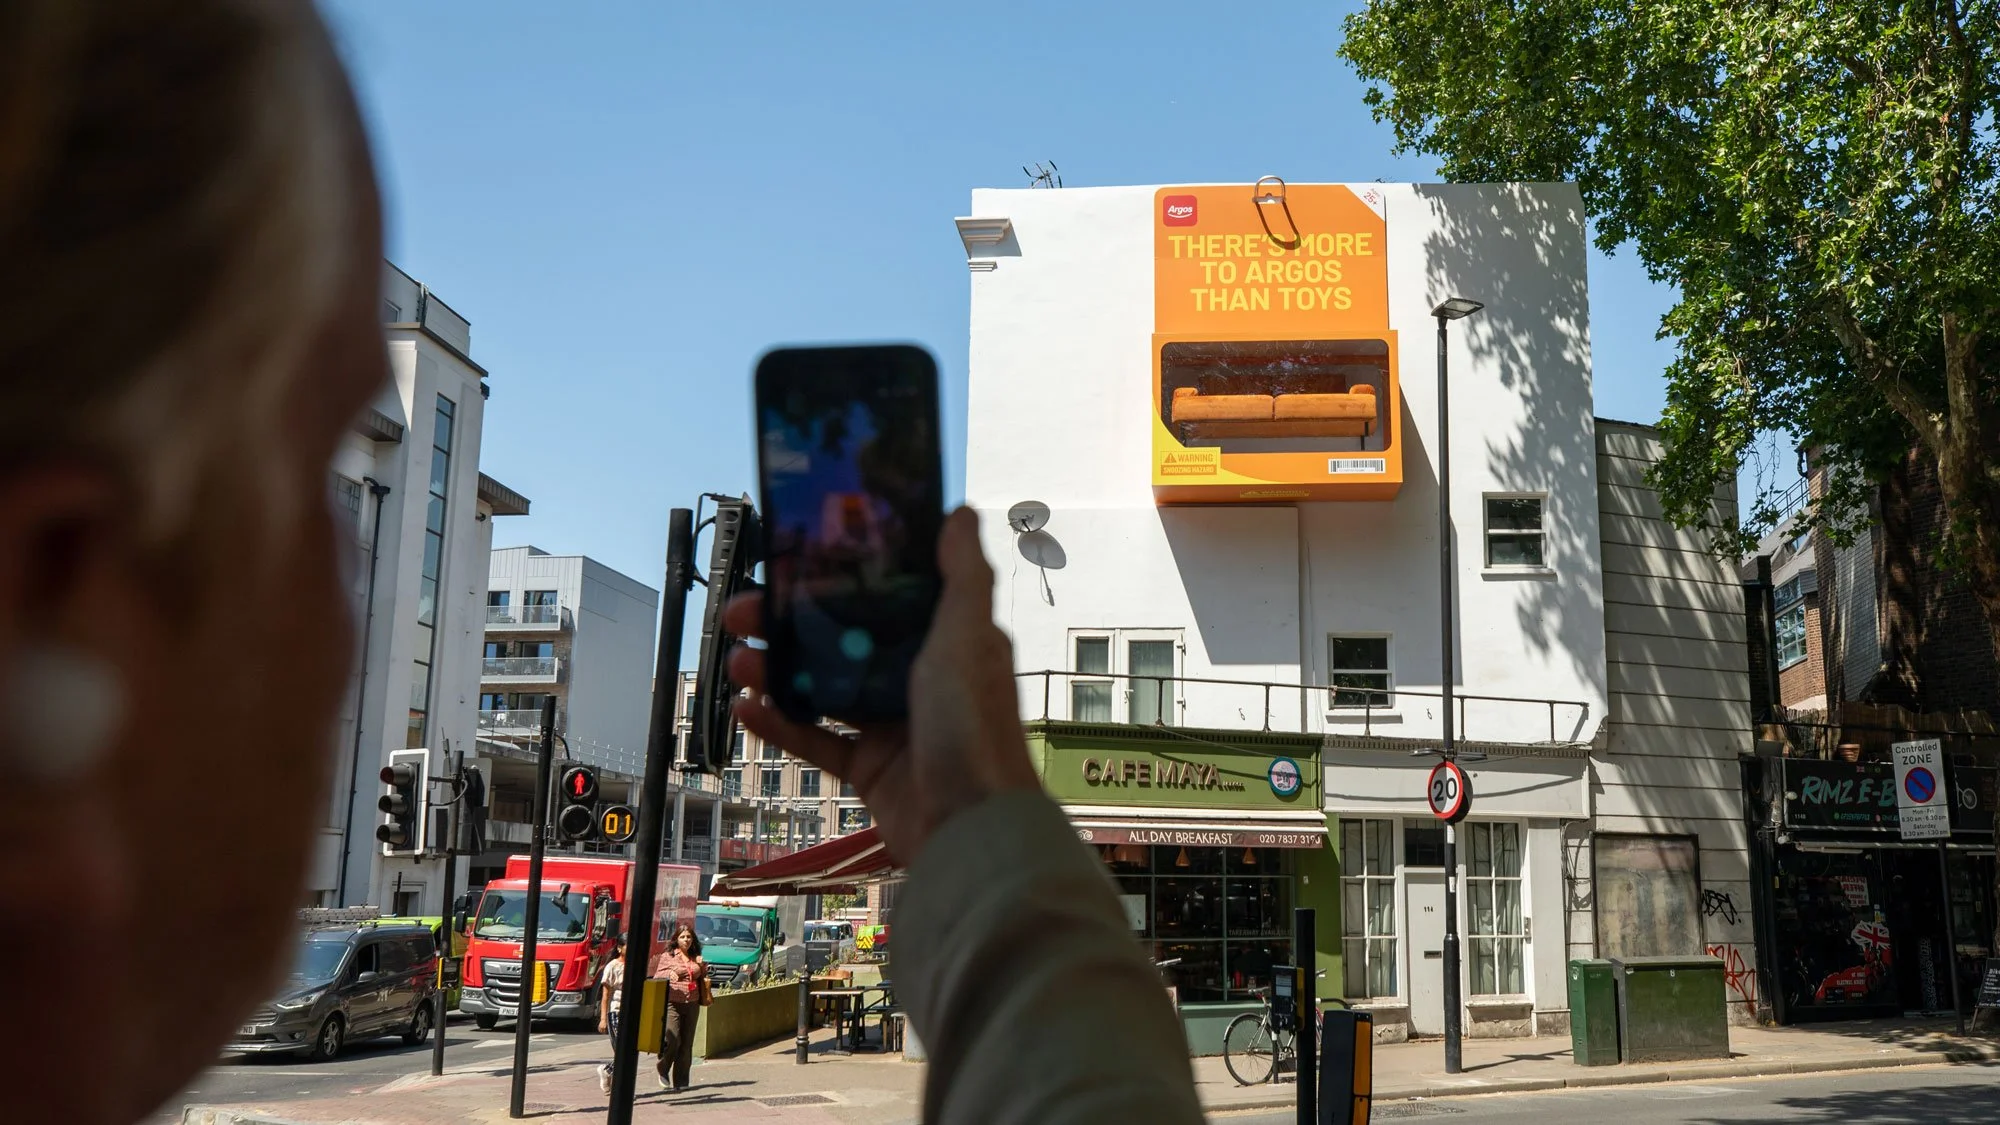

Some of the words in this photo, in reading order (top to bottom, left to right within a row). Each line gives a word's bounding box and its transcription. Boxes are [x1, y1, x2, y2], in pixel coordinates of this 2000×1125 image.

[1167, 204, 1193, 215] Argos
[1168, 233, 1286, 259] THERE'S
[1294, 232, 1373, 257] MORE
[1200, 261, 1237, 285] TO
[1244, 259, 1342, 284] ARGOS
[1190, 288, 1270, 312] THAN
[1278, 286, 1352, 311] TOYS
[1177, 452, 1214, 463] WARNING
[1895, 743, 1938, 754] Controlled
[1902, 754, 1932, 765] ZONE
[1083, 758, 1150, 783] CAFE
[1156, 760, 1221, 786] MAYA
[1433, 777, 1458, 802] 20
[1857, 778, 1897, 807] E-B
[605, 813, 631, 835] 01
[1129, 831, 1148, 843] ALL
[1150, 831, 1172, 843] DAY
[1175, 832, 1233, 845] BREAKFAST
[1259, 834, 1276, 844] 020
[1278, 835, 1298, 844] 7837
